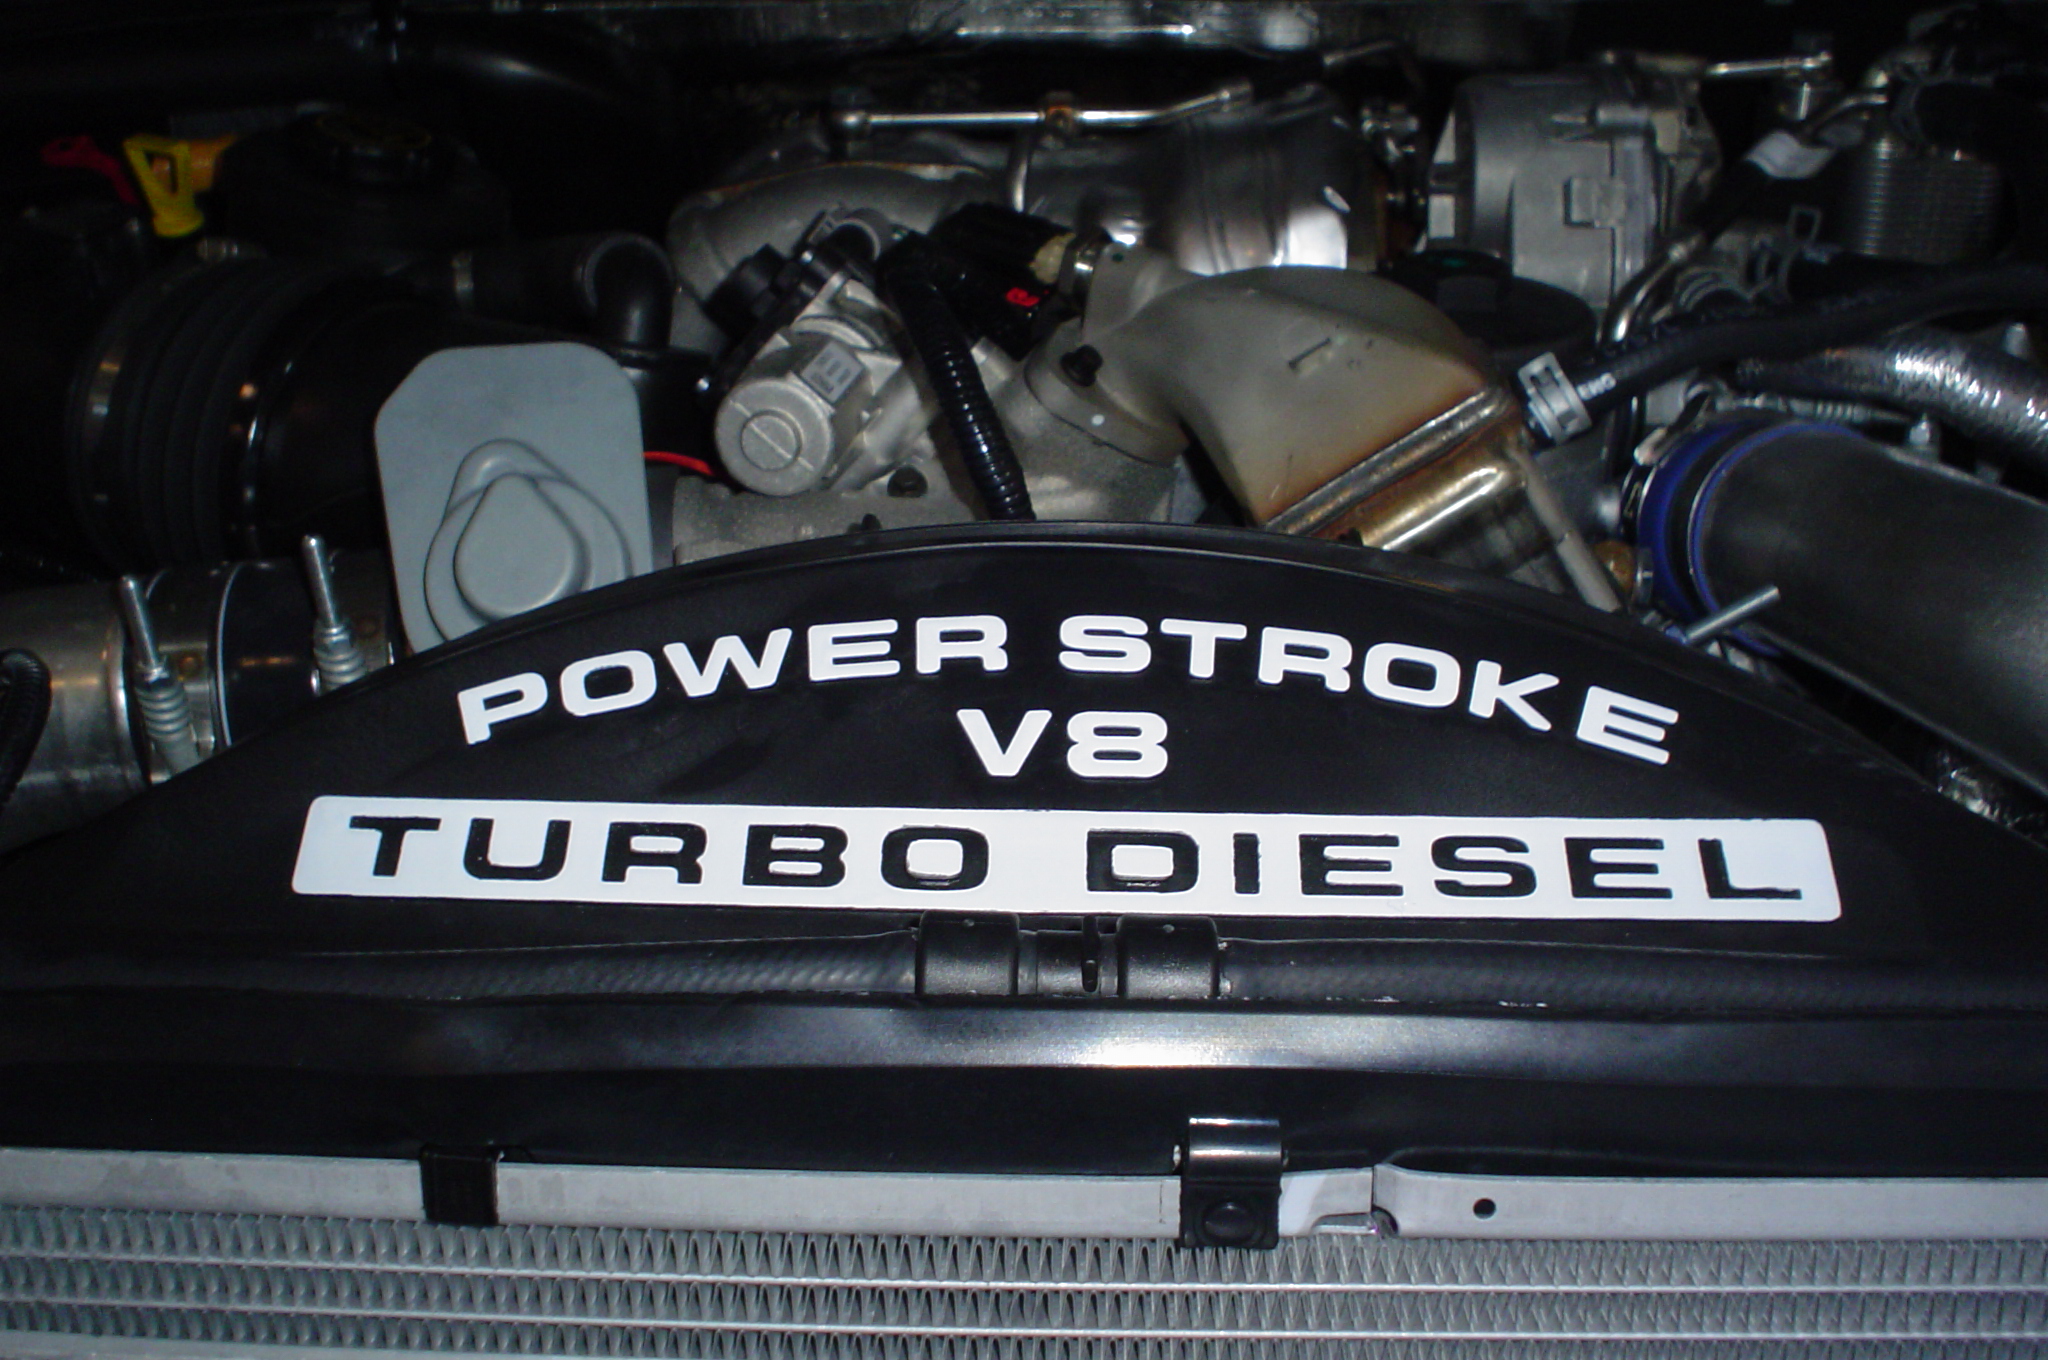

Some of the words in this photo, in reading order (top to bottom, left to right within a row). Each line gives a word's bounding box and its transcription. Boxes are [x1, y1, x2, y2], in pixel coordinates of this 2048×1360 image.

[457, 614, 1009, 745] POWER
[1058, 614, 1679, 765] STROKE
[956, 708, 1169, 778] V8
[348, 815, 989, 891] TURBO
[1086, 830, 1802, 900] DIESEL
